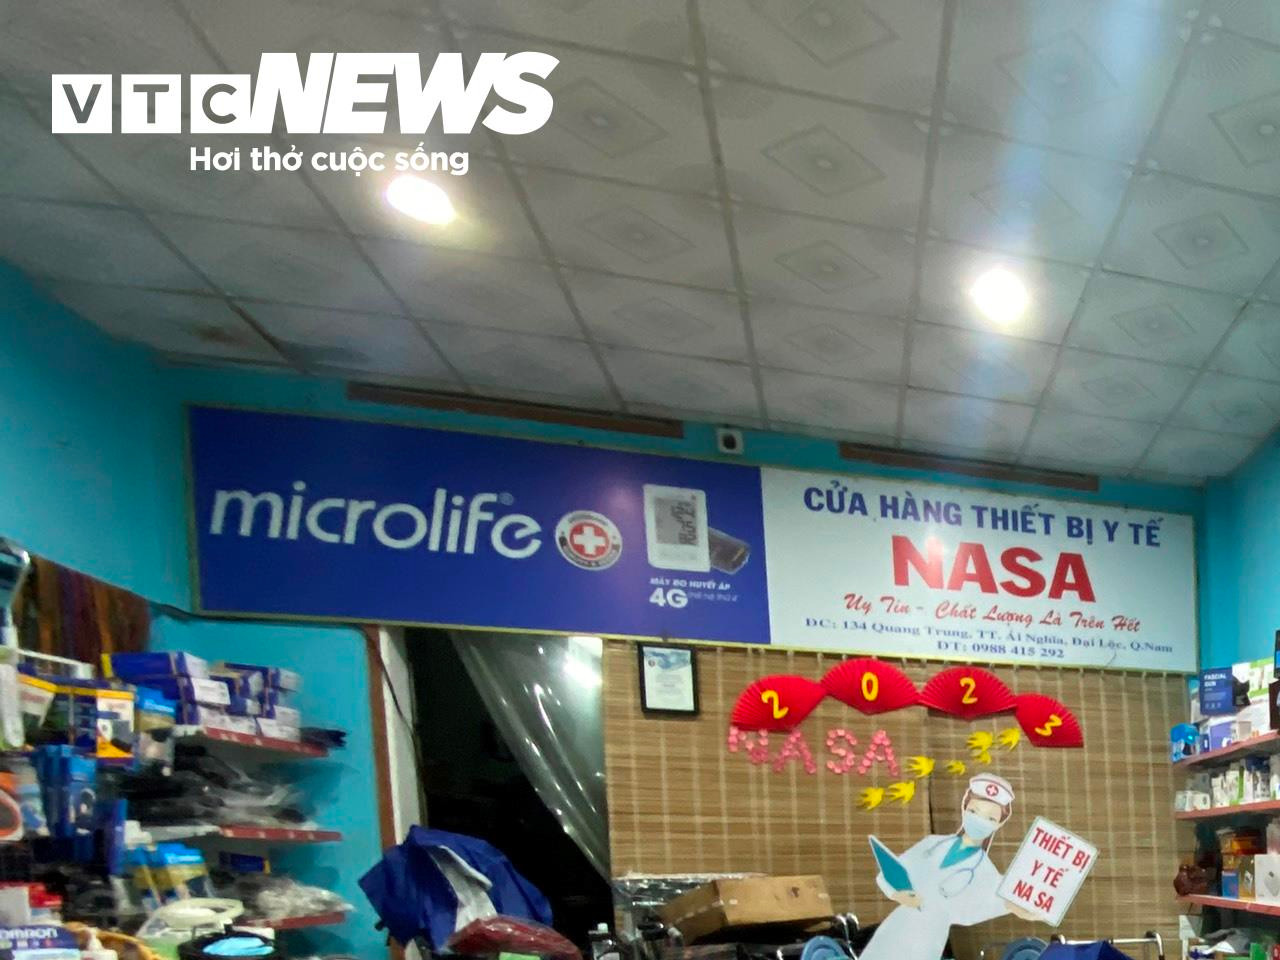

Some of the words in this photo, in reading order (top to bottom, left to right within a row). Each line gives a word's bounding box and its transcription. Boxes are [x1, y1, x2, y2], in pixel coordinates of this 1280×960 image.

[210, 481, 543, 560] microlife
[804, 480, 868, 517] CỬA
[879, 490, 963, 527] HÀNG
[971, 503, 1056, 536] THIẾT
[1066, 516, 1093, 547] BỊ
[1103, 520, 1119, 543] Y
[1128, 518, 1165, 548] TẾ
[891, 535, 1096, 604] NASA
[650, 588, 688, 609] 4G
[844, 593, 872, 615] Uy
[935, 600, 978, 622] Chất
[982, 605, 1034, 629] Lượng
[1039, 609, 1064, 627] Là
[1070, 613, 1106, 631] Trên
[1111, 615, 1142, 633] Hết
[843, 620, 867, 632] 134
[872, 622, 921, 637] Quang
[972, 642, 1007, 656] 0988
[1010, 645, 1036, 658] 415
[1040, 647, 1066, 659] 292
[1031, 827, 1074, 859] THIẾT
[1072, 850, 1091, 873] BỊ
[1031, 859, 1043, 877] Y
[1043, 866, 1069, 888] TẾ
[1012, 879, 1034, 901] NA
[1034, 891, 1055, 912] SA
